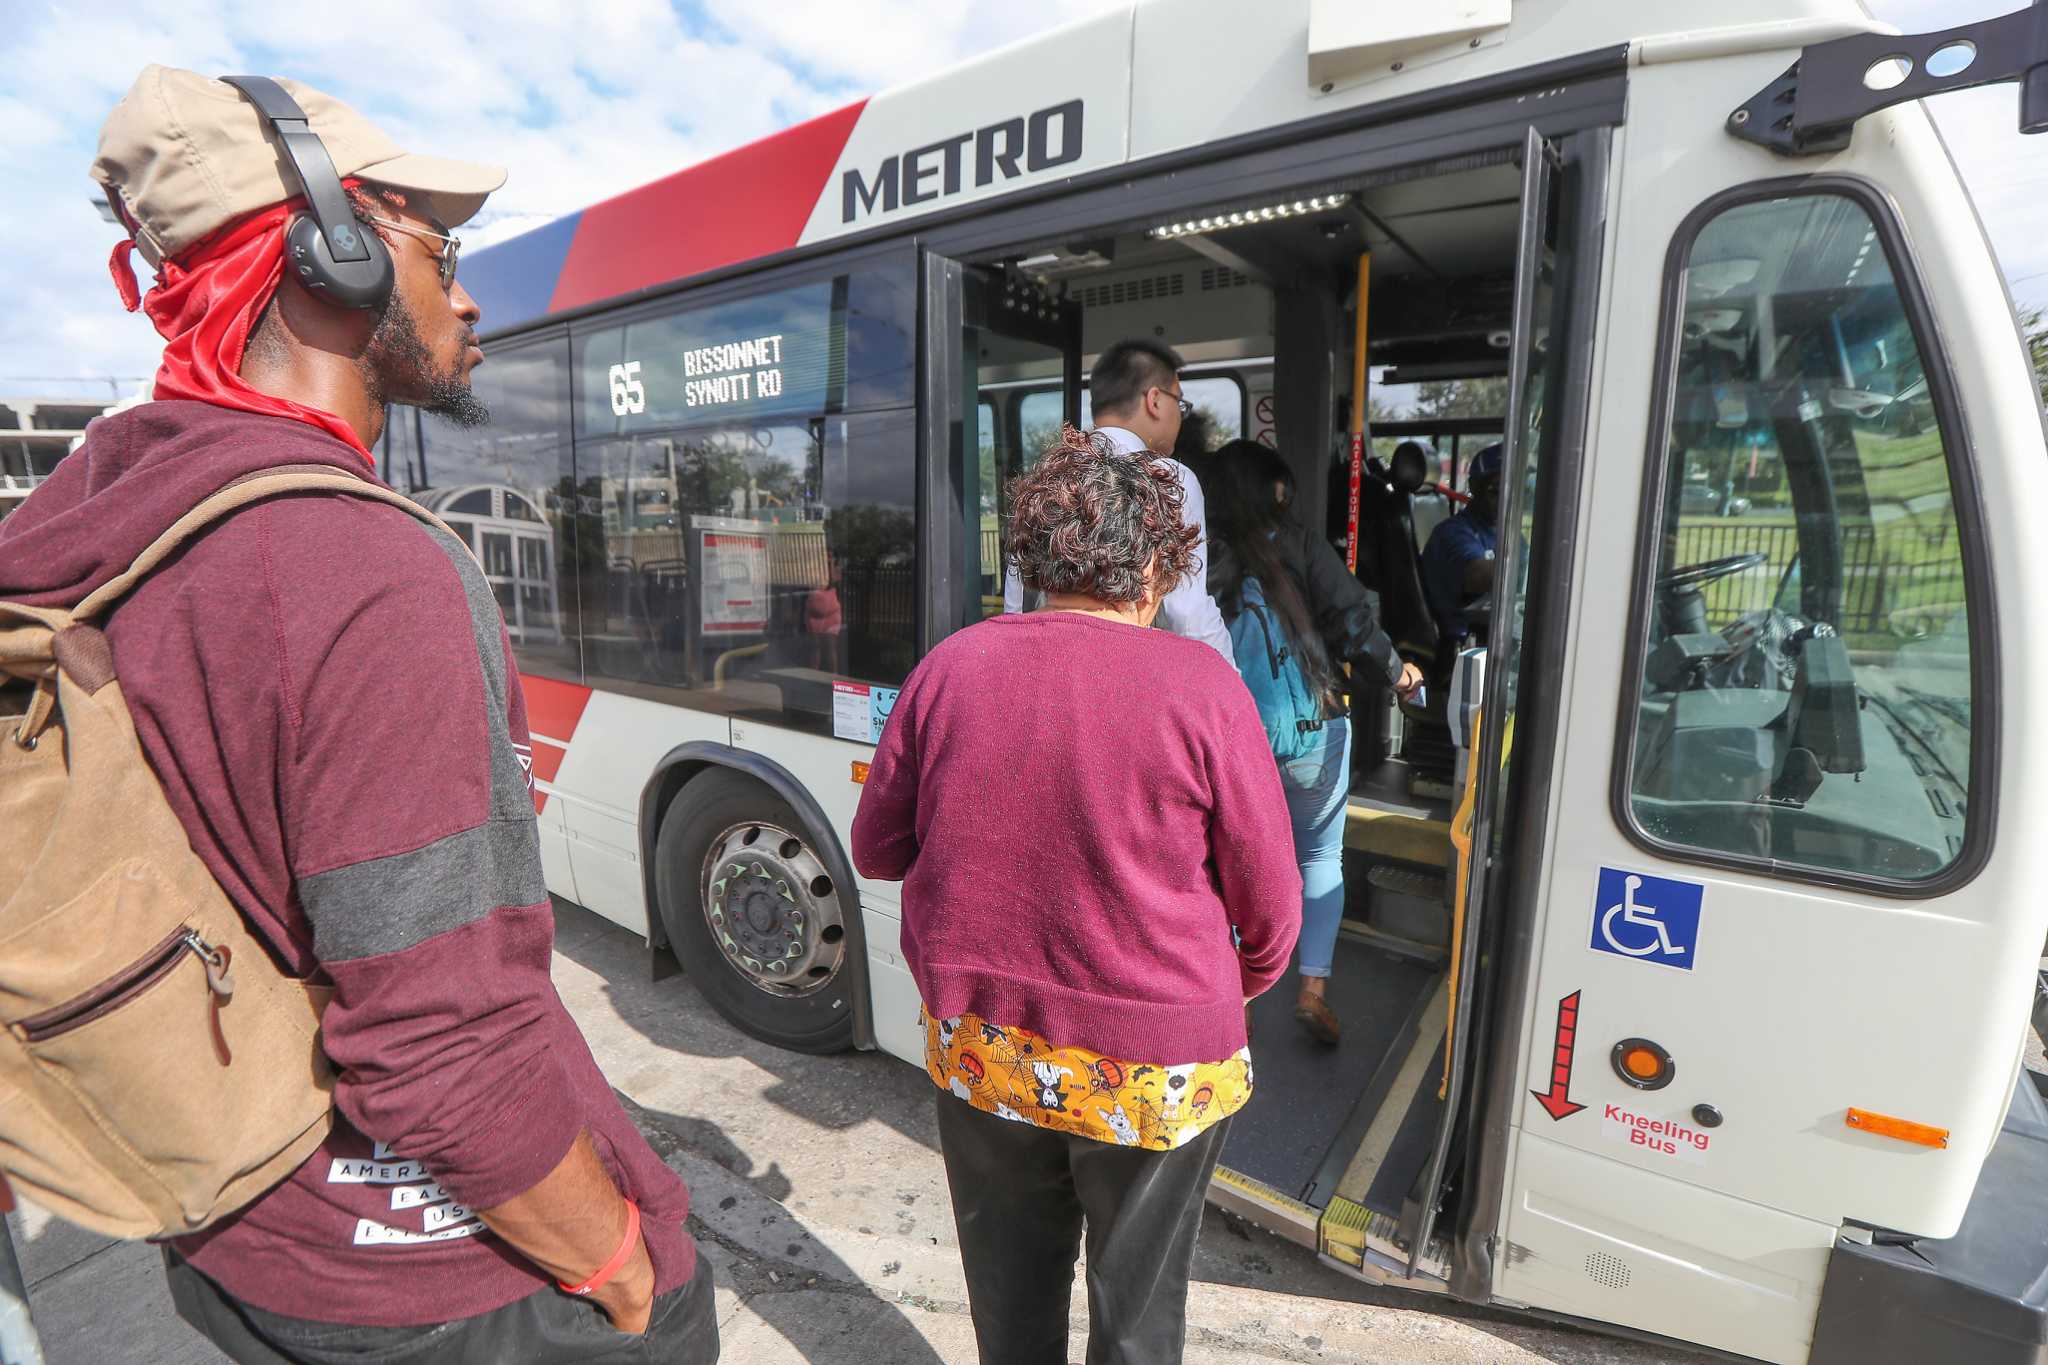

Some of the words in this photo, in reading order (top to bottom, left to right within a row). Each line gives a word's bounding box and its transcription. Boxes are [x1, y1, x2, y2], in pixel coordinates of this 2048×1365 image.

[842, 98, 1084, 224] METRO
[683, 335, 782, 377] BISSONNET
[609, 361, 645, 416] 65
[685, 373, 751, 407] SYNOTT
[756, 368, 782, 398] RD
[1351, 434, 1361, 477] WATCH
[1349, 488, 1358, 522] YOUR
[1346, 532, 1354, 566] STEP
[1604, 1103, 1710, 1151] Kneeling
[1630, 1128, 1677, 1155] Bus
[340, 1164, 429, 1178] AMERI
[433, 1204, 464, 1222] US
